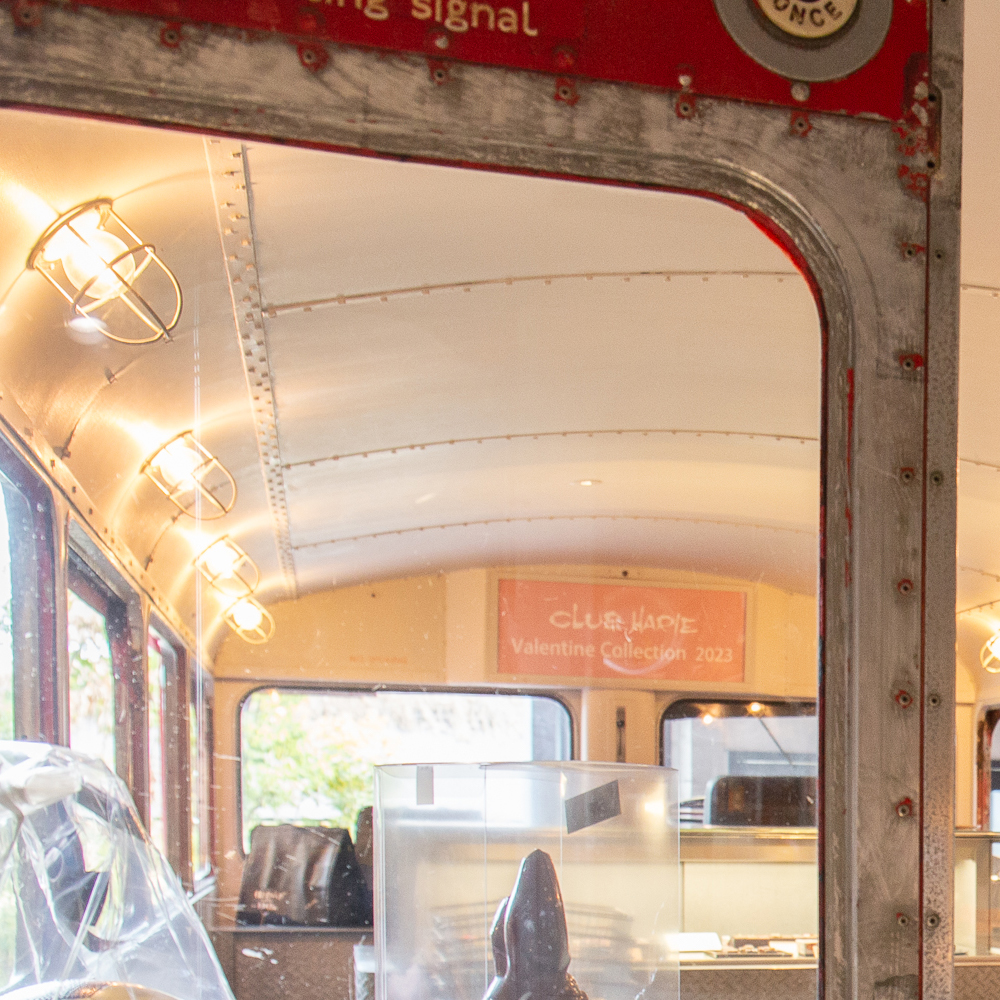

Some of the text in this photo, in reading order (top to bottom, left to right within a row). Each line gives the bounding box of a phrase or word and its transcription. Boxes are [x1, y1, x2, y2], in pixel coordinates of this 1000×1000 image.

[411, 0, 538, 36] signal
[511, 637, 734, 663] Valentine Collection 2023
